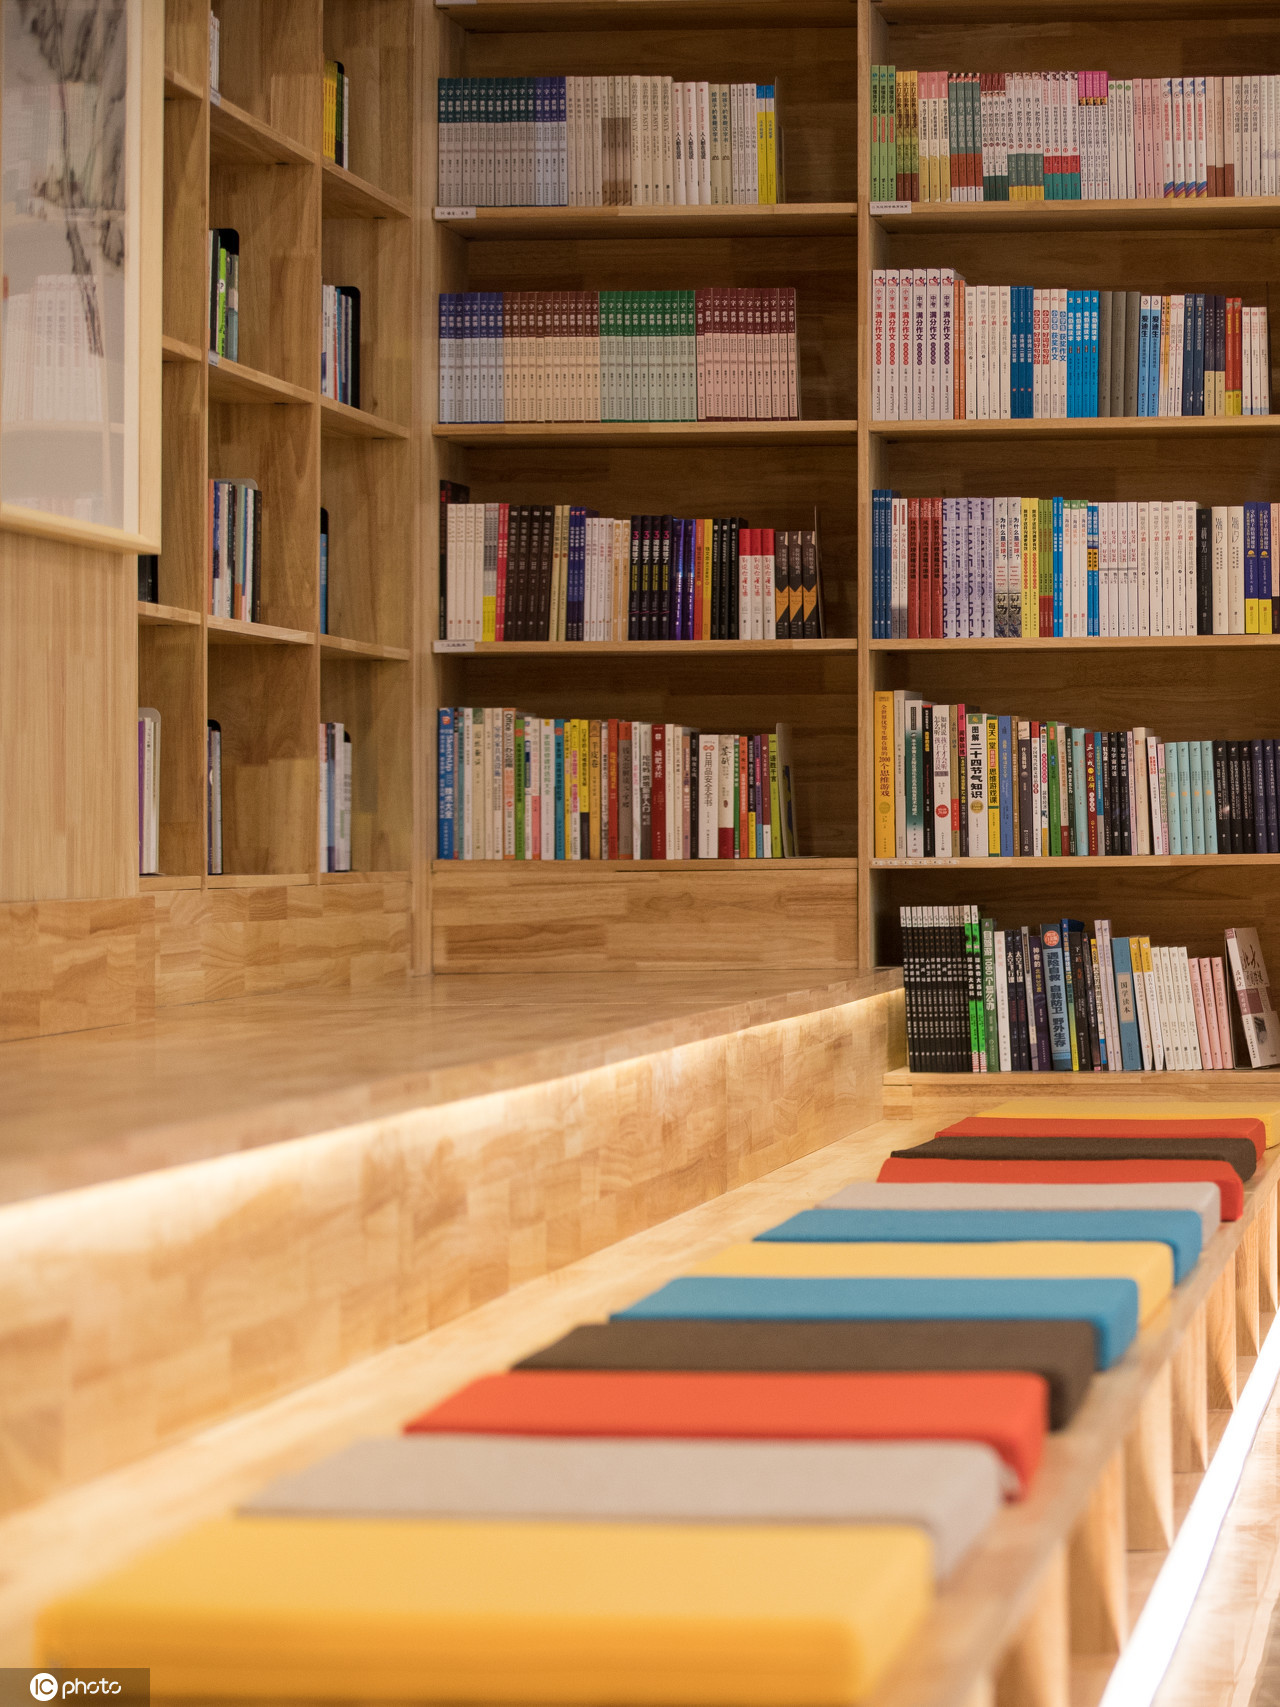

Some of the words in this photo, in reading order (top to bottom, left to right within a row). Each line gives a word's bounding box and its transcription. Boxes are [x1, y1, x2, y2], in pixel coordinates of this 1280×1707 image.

[888, 311, 896, 341] 满分作文
[902, 311, 910, 341] 满分作文
[915, 311, 923, 341] 满分作文
[929, 311, 937, 341] 满分作文
[943, 311, 951, 341] 满分作文
[505, 713, 513, 732] Office
[969, 725, 983, 799] 图解二十四节气知识
[1119, 981, 1132, 1015] 国学读本
